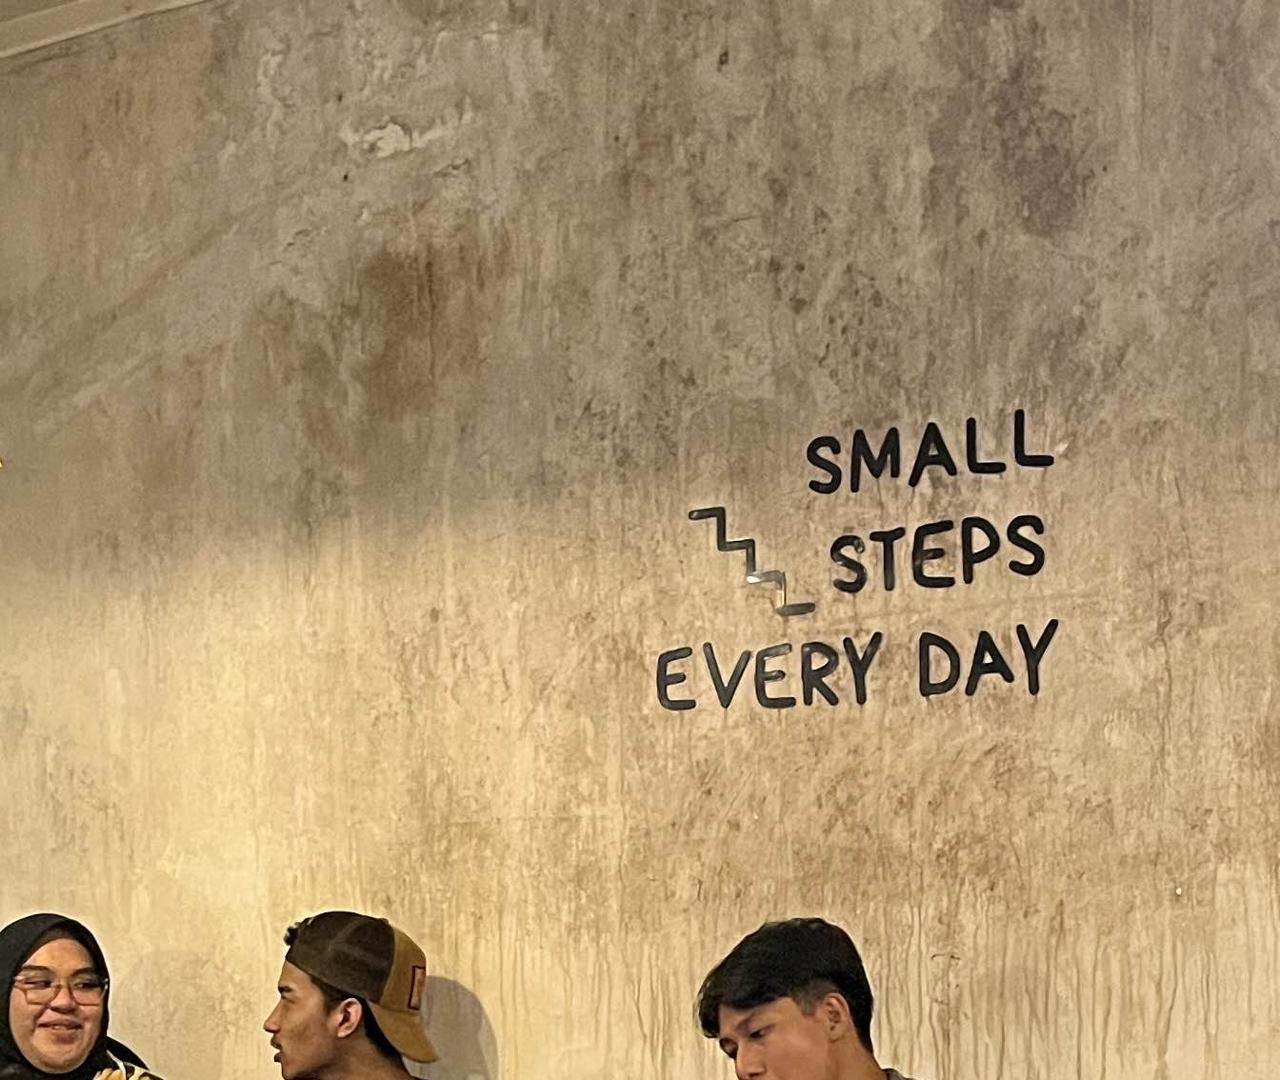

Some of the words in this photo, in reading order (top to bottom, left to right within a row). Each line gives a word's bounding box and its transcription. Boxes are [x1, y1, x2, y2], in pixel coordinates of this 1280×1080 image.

[806, 408, 1055, 494] SMALL
[830, 514, 1046, 594] STEPS
[656, 631, 882, 711] EVERY
[919, 618, 1059, 697] DAY
